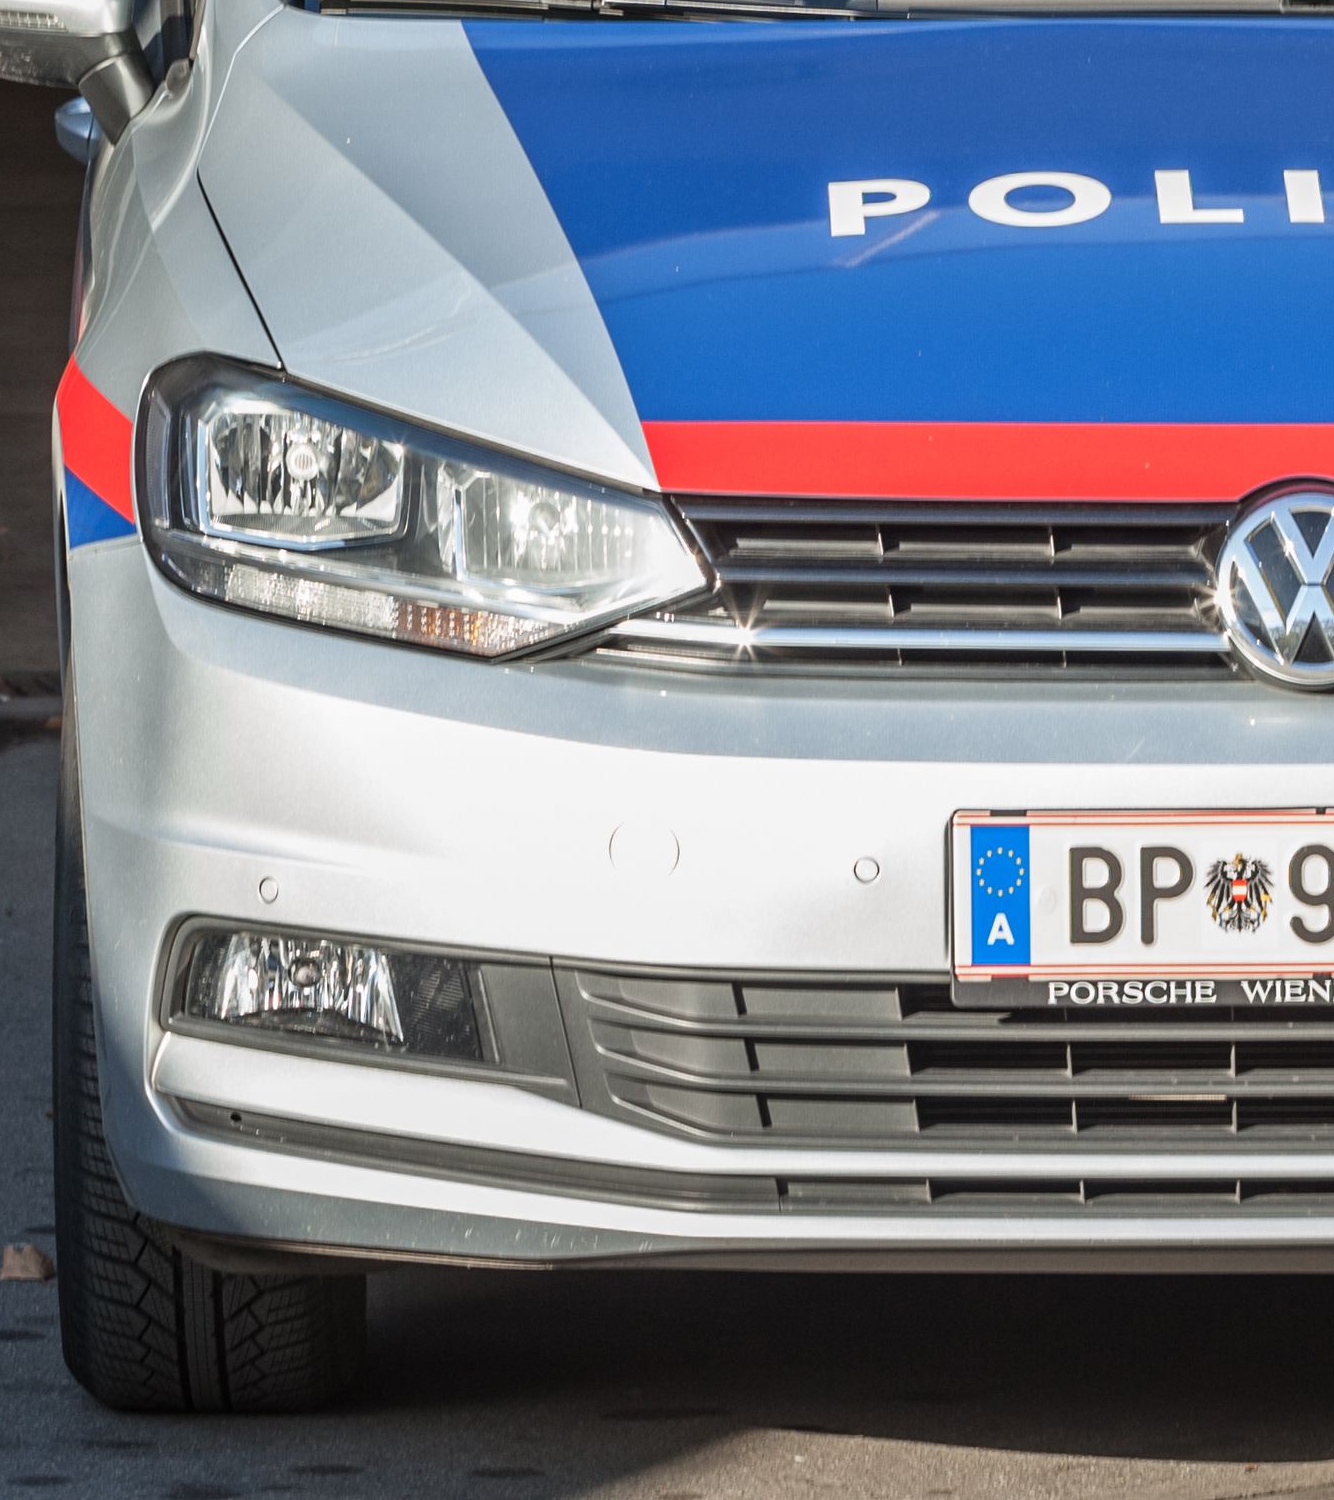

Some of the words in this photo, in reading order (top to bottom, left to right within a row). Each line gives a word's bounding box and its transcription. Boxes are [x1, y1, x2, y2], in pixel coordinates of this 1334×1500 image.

[1069, 846, 1194, 945] BP
[987, 912, 1015, 946] A
[1047, 980, 1218, 1006] PORSCHE
